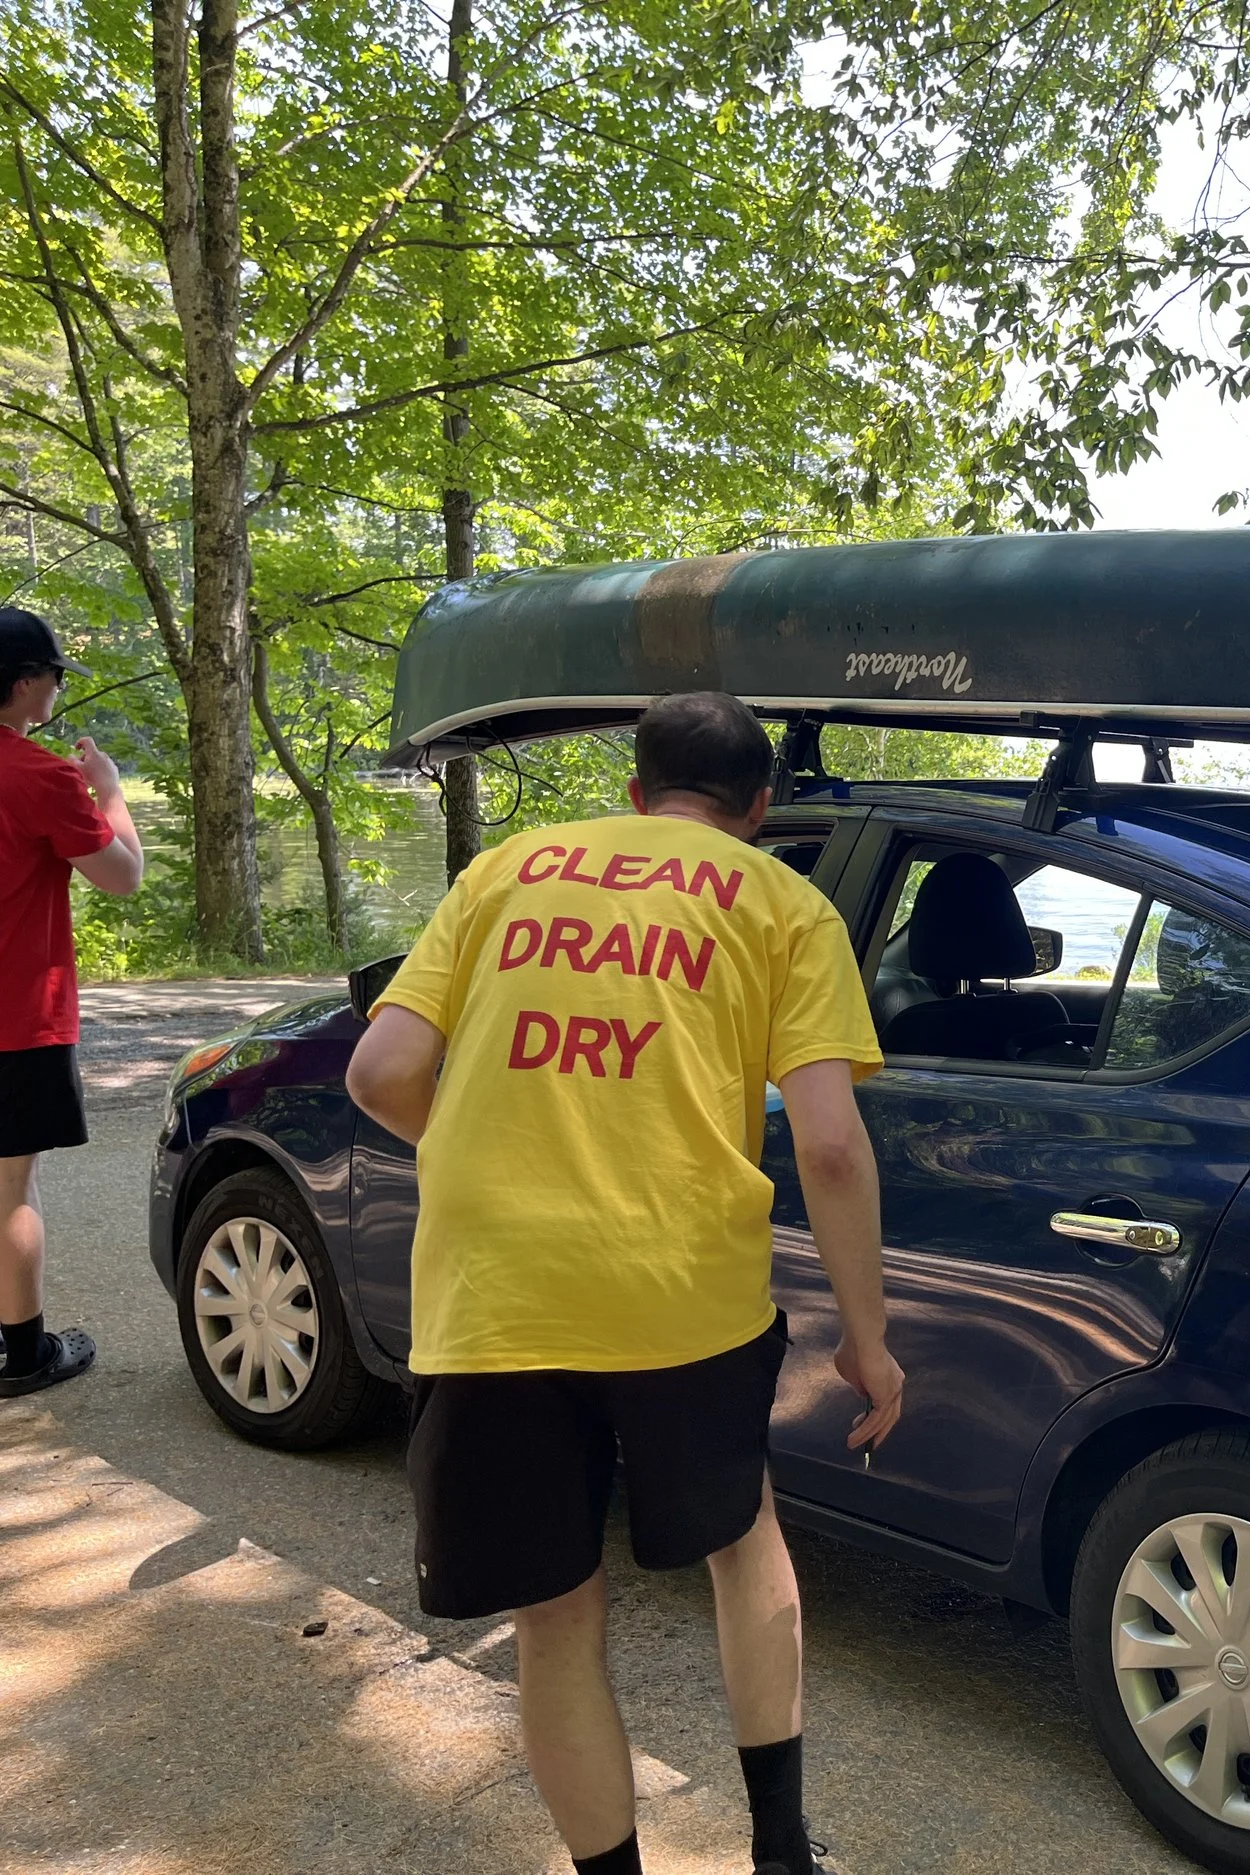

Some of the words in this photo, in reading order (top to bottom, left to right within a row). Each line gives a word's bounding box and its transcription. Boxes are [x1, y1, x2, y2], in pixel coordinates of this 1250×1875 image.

[845, 651, 973, 694] Northeast
[517, 845, 745, 912] CLEAN
[497, 916, 717, 993] DRAIN
[507, 1010, 663, 1080] DRY
